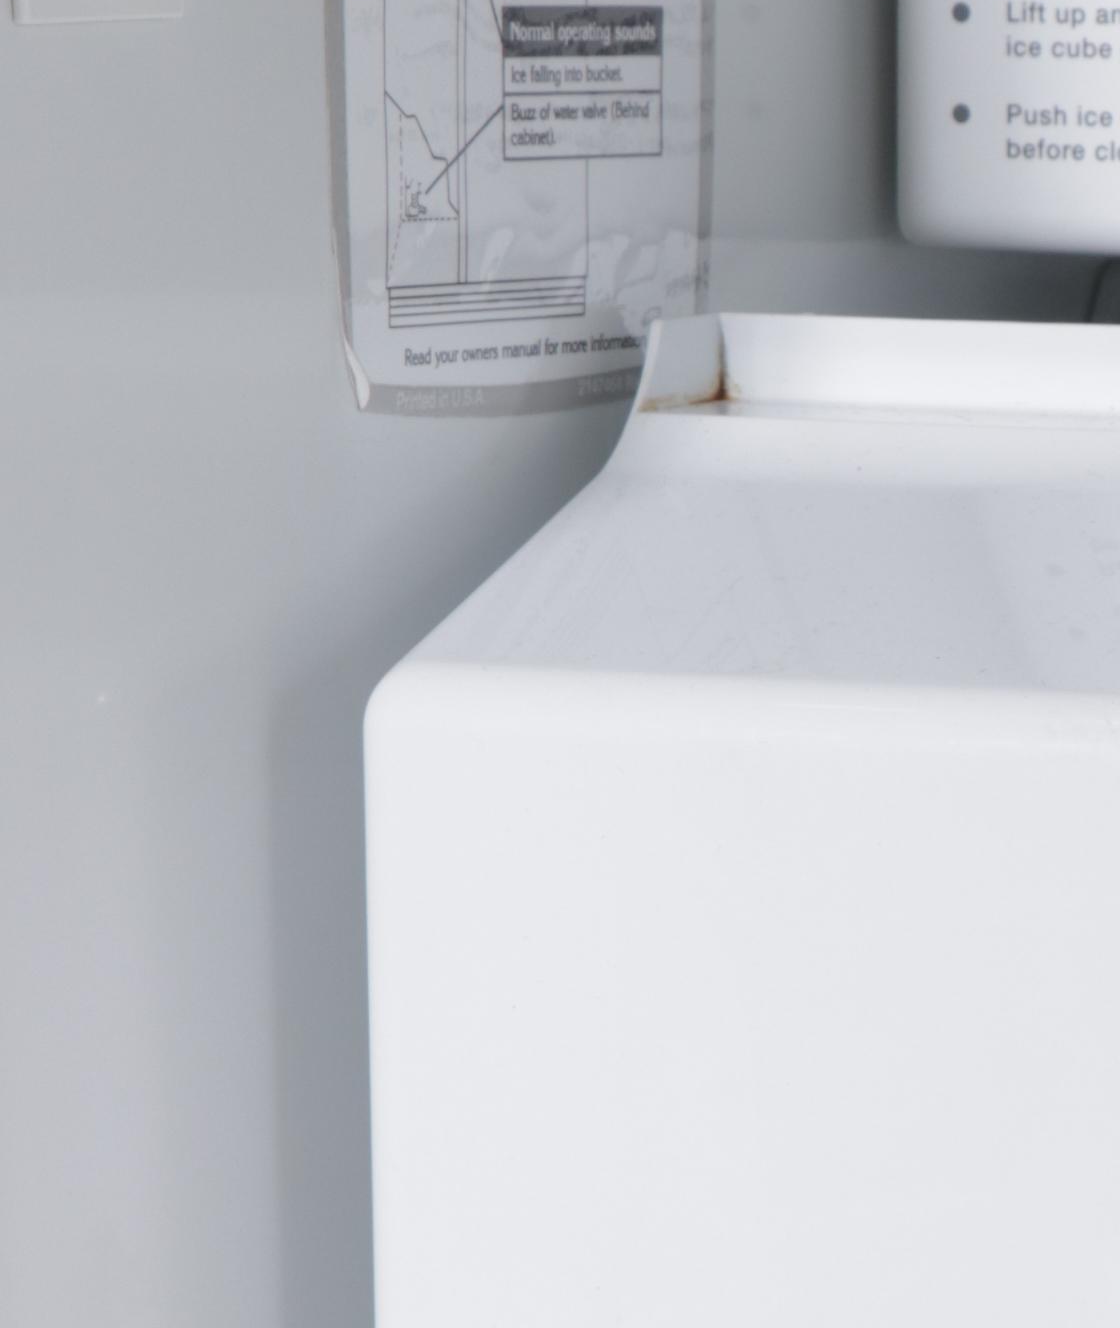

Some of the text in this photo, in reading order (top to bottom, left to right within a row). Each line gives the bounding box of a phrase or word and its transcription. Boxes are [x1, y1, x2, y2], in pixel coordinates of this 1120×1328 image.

[1005, 0, 1045, 25] Lift
[1054, 7, 1087, 29] up
[510, 22, 656, 45] Normal operating sounds
[1005, 34, 1042, 59] ice
[1049, 37, 1113, 60] cube
[511, 66, 526, 83] Ice
[530, 66, 561, 87] falling
[564, 68, 583, 82] into
[511, 104, 536, 121] Buzz
[540, 104, 550, 120] of
[553, 107, 579, 120] water
[1004, 102, 1067, 127] Push
[1076, 105, 1113, 128] ice
[1003, 136, 1085, 161] before
[404, 347, 431, 366] Read
[434, 350, 458, 368] your
[462, 346, 498, 362] owners
[502, 339, 542, 358] manual
[545, 337, 559, 355] for
[561, 340, 588, 354] more
